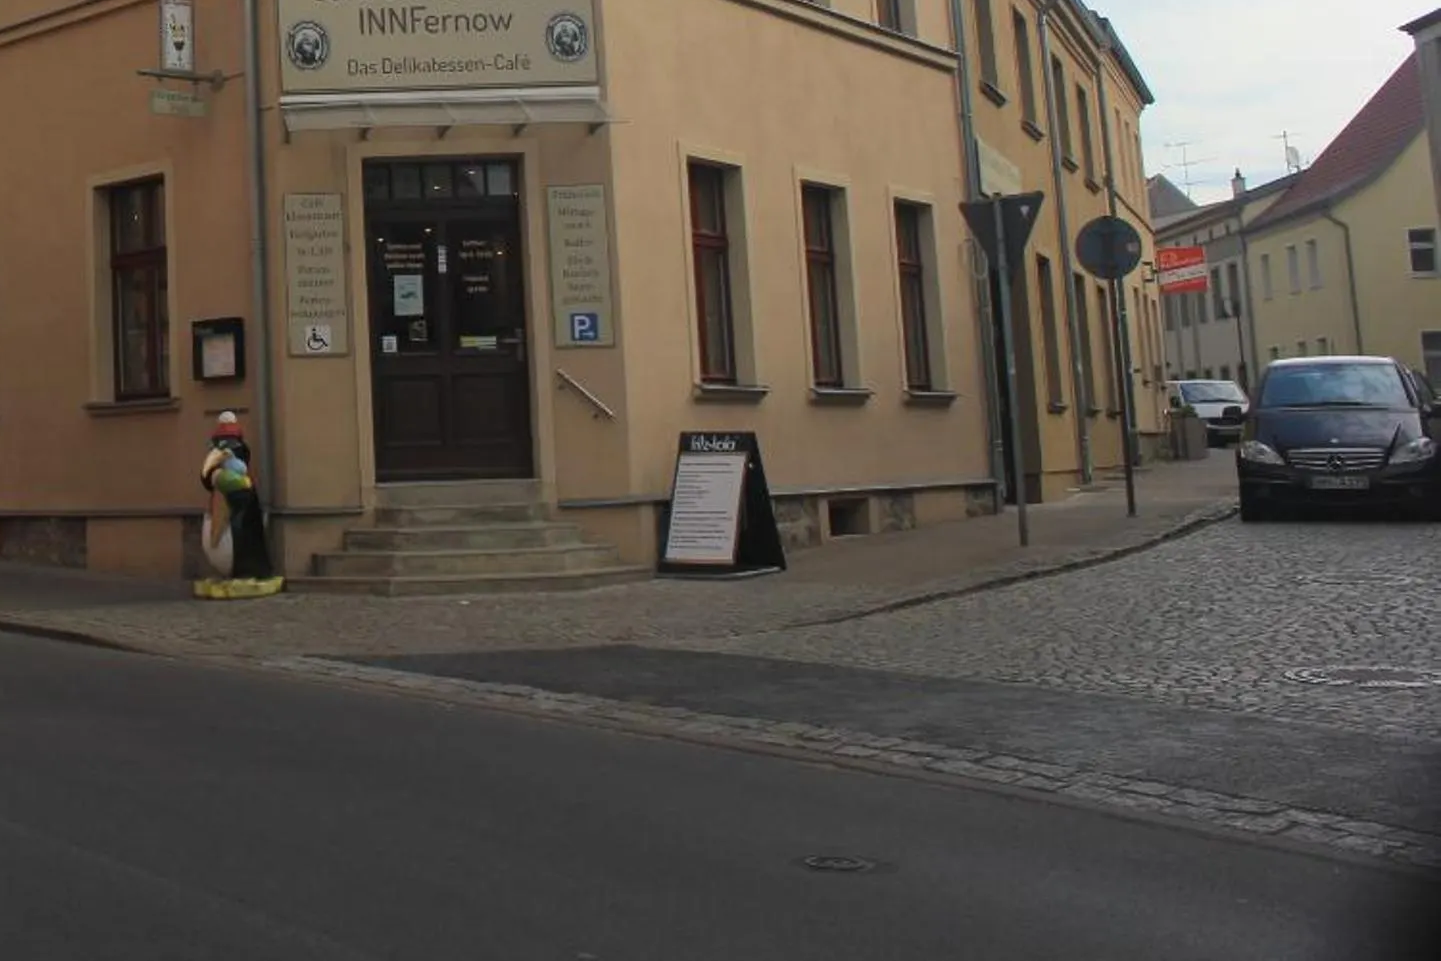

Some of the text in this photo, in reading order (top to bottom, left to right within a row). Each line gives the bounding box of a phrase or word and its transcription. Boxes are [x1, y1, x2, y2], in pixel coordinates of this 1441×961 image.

[359, 6, 512, 36] INNFernow
[347, 58, 378, 77] Das
[574, 315, 591, 339] P
